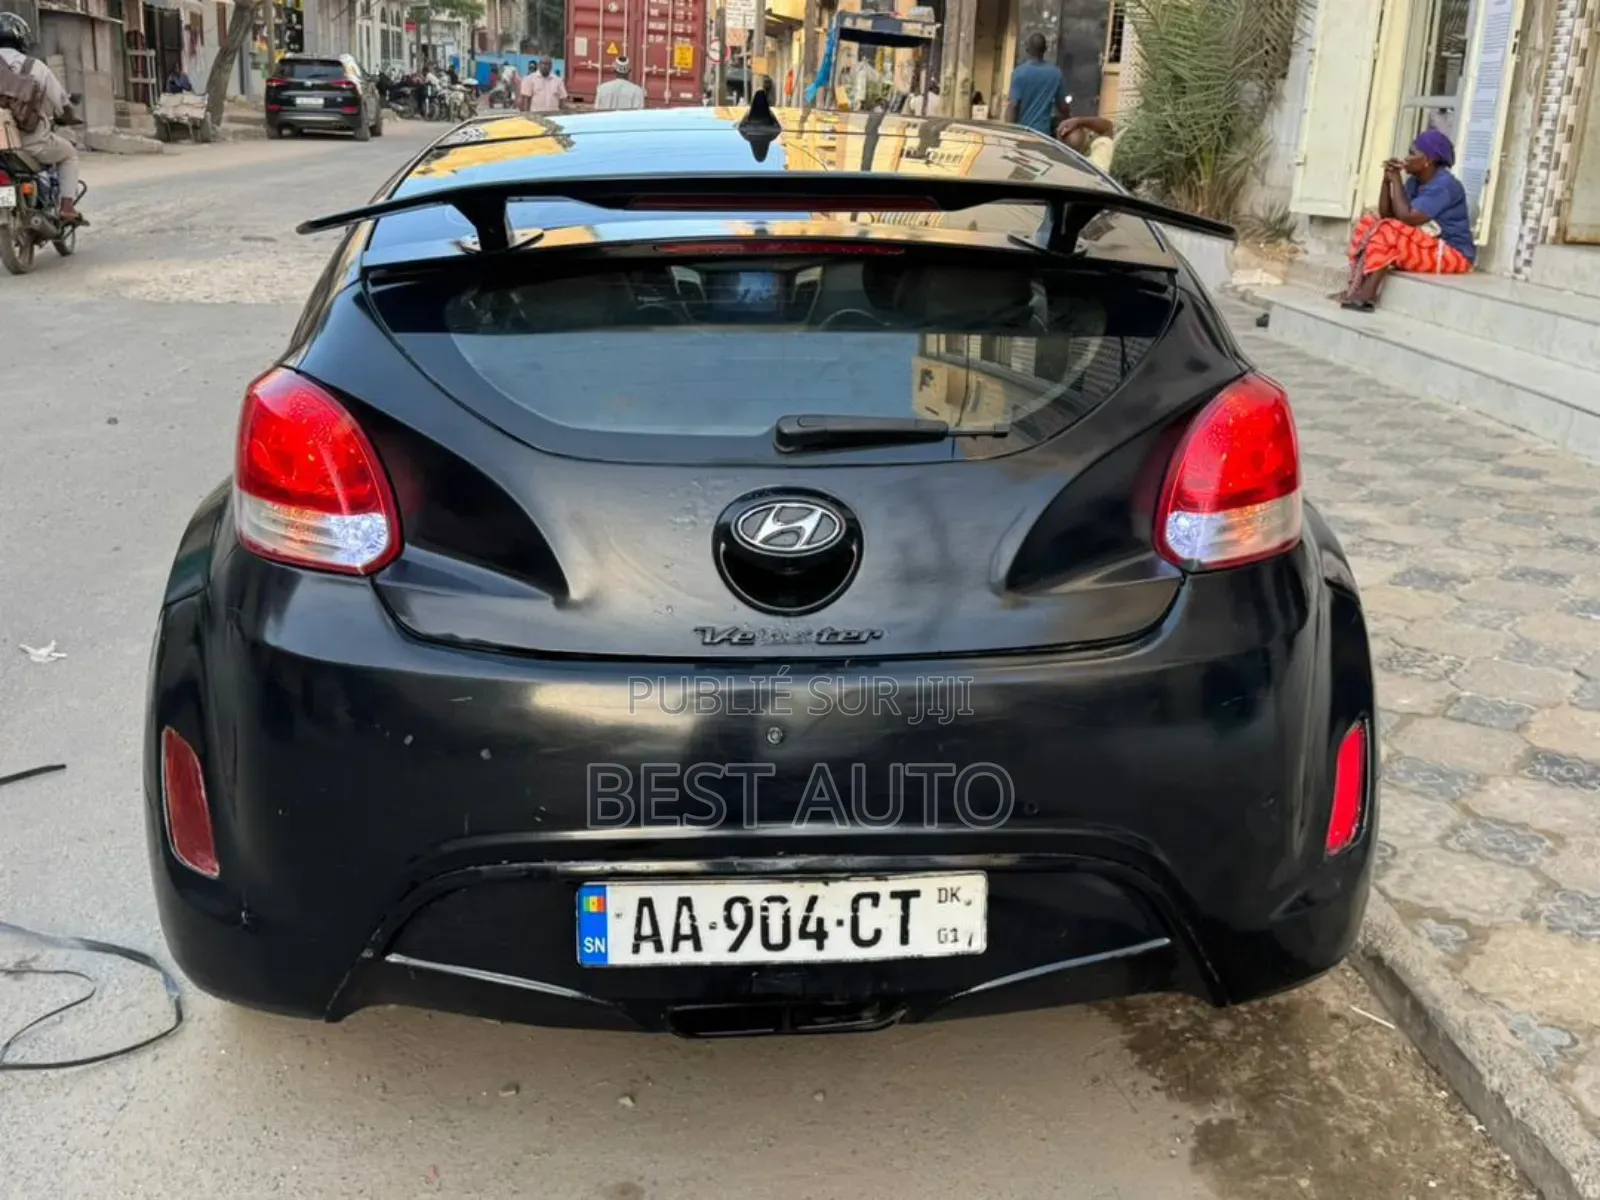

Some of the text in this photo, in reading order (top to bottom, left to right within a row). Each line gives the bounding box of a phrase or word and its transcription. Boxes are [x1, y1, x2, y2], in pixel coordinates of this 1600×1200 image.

[693, 626, 885, 646] Veter
[937, 886, 962, 904] DK
[584, 936, 607, 953] SN
